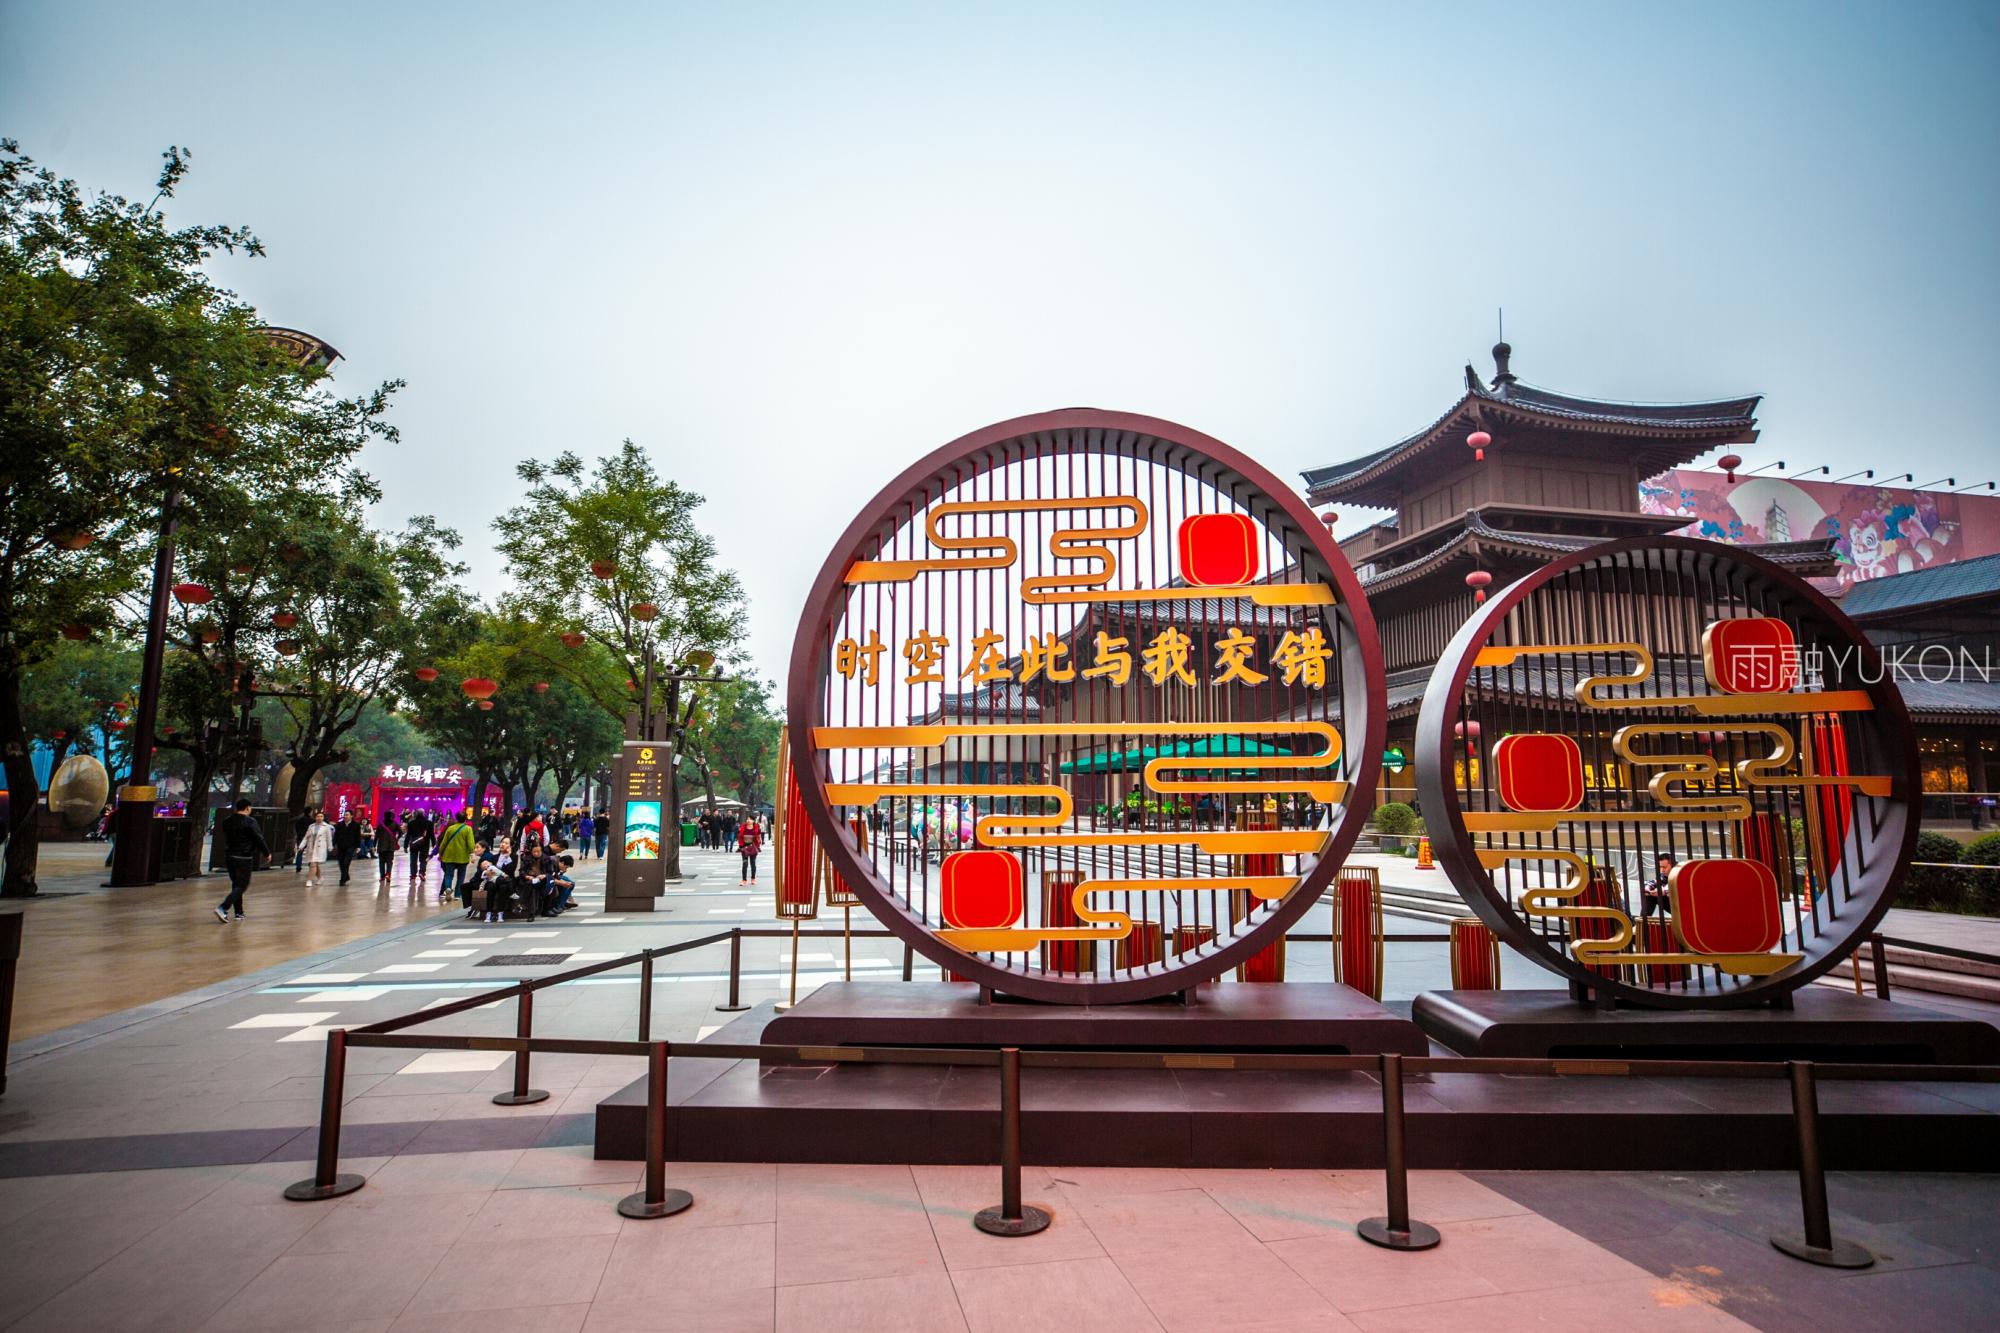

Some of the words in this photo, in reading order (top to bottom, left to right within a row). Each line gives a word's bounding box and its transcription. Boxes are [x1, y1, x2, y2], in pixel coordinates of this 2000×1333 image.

[836, 625, 1334, 689] 时空在此与我交错
